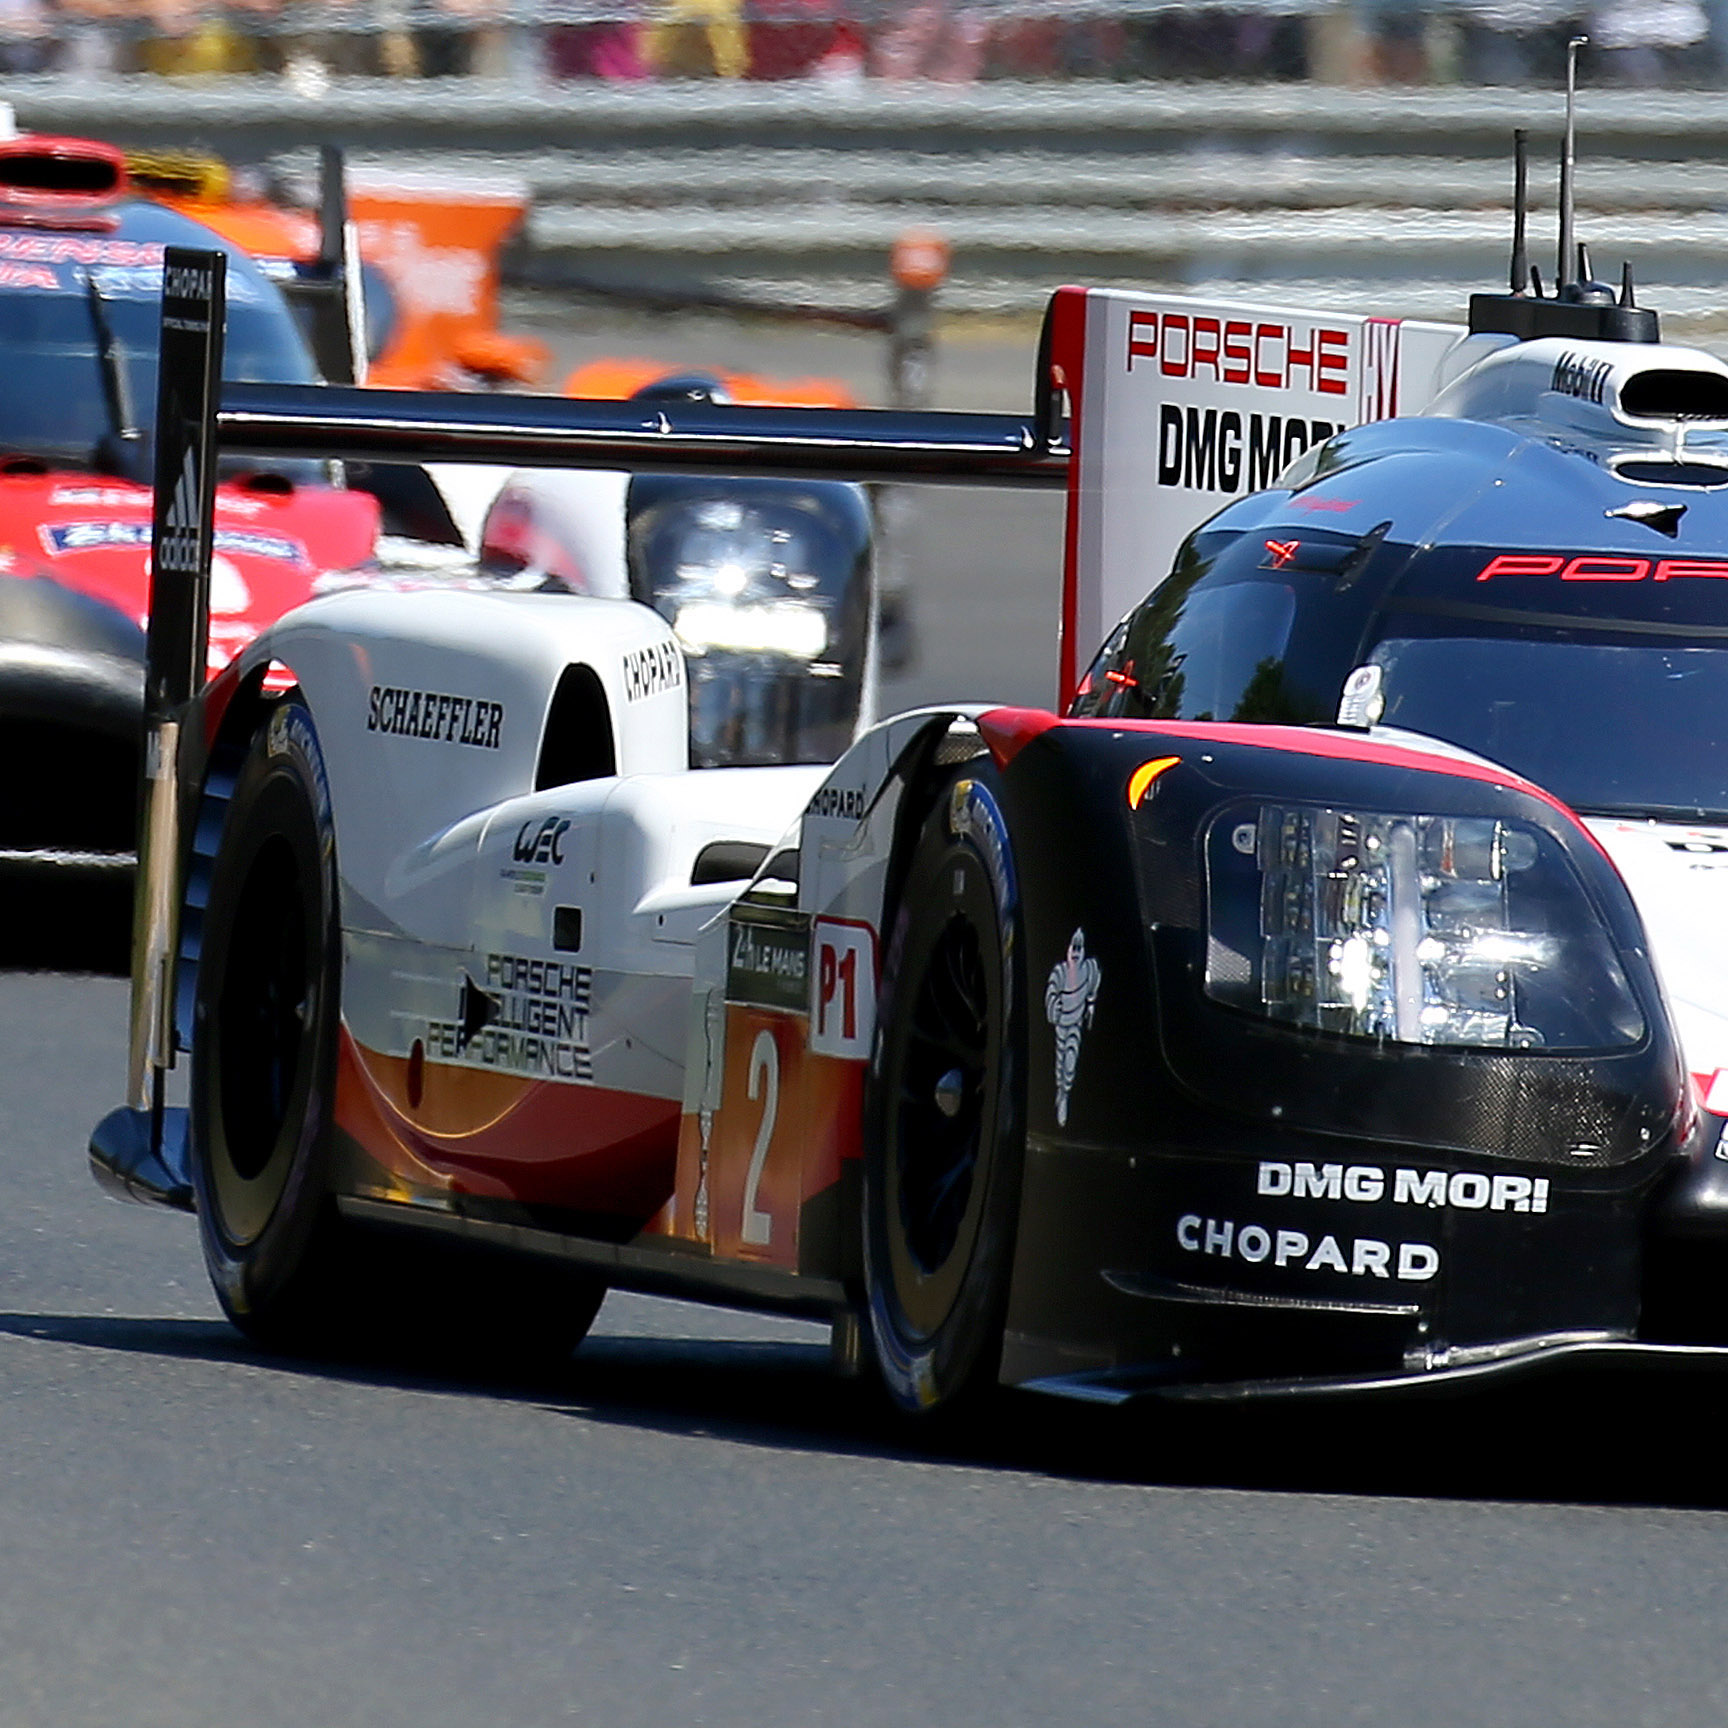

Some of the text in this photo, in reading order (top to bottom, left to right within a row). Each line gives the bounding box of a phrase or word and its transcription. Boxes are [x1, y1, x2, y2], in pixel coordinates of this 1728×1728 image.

[1127, 310, 1349, 396] PORSCHE
[1551, 350, 1596, 402] Mobil
[1158, 403, 1242, 493] DMG
[622, 639, 682, 703] CHOPARD
[368, 685, 504, 750] SCHAEFFLER
[513, 816, 572, 865] WEC
[487, 954, 593, 1004] PORSCHE
[817, 943, 857, 1041] P1
[741, 1029, 780, 1245] 2
[1257, 1160, 1550, 1213] DMG MORI
[1176, 1214, 1440, 1280] CHOPARD
